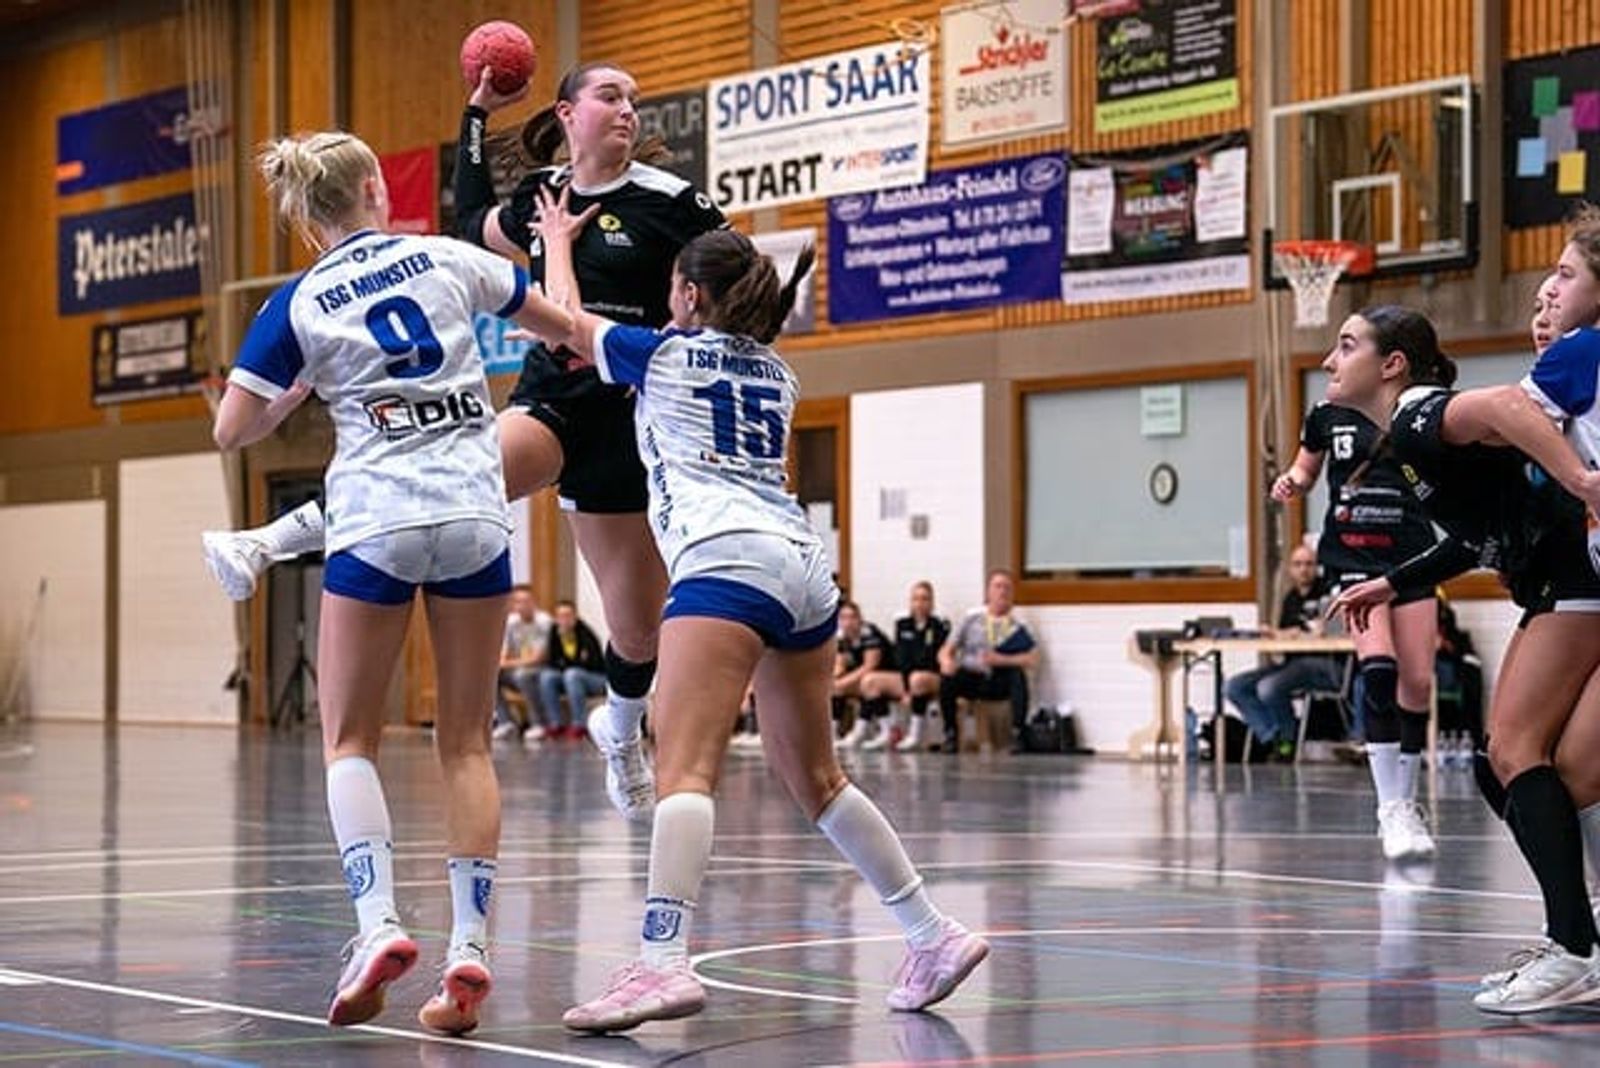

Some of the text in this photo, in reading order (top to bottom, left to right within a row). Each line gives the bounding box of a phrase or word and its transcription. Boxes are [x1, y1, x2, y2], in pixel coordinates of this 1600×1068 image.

[716, 50, 920, 130] SPORT SAAR
[956, 72, 1053, 111] BAUSTOFFE
[716, 153, 823, 208] START
[313, 283, 353, 314] TSG
[349, 252, 435, 299] MÜNSTER
[364, 294, 445, 379] 9
[686, 347, 719, 369] TSG
[692, 378, 785, 460] 15
[1332, 433, 1355, 460] 13
